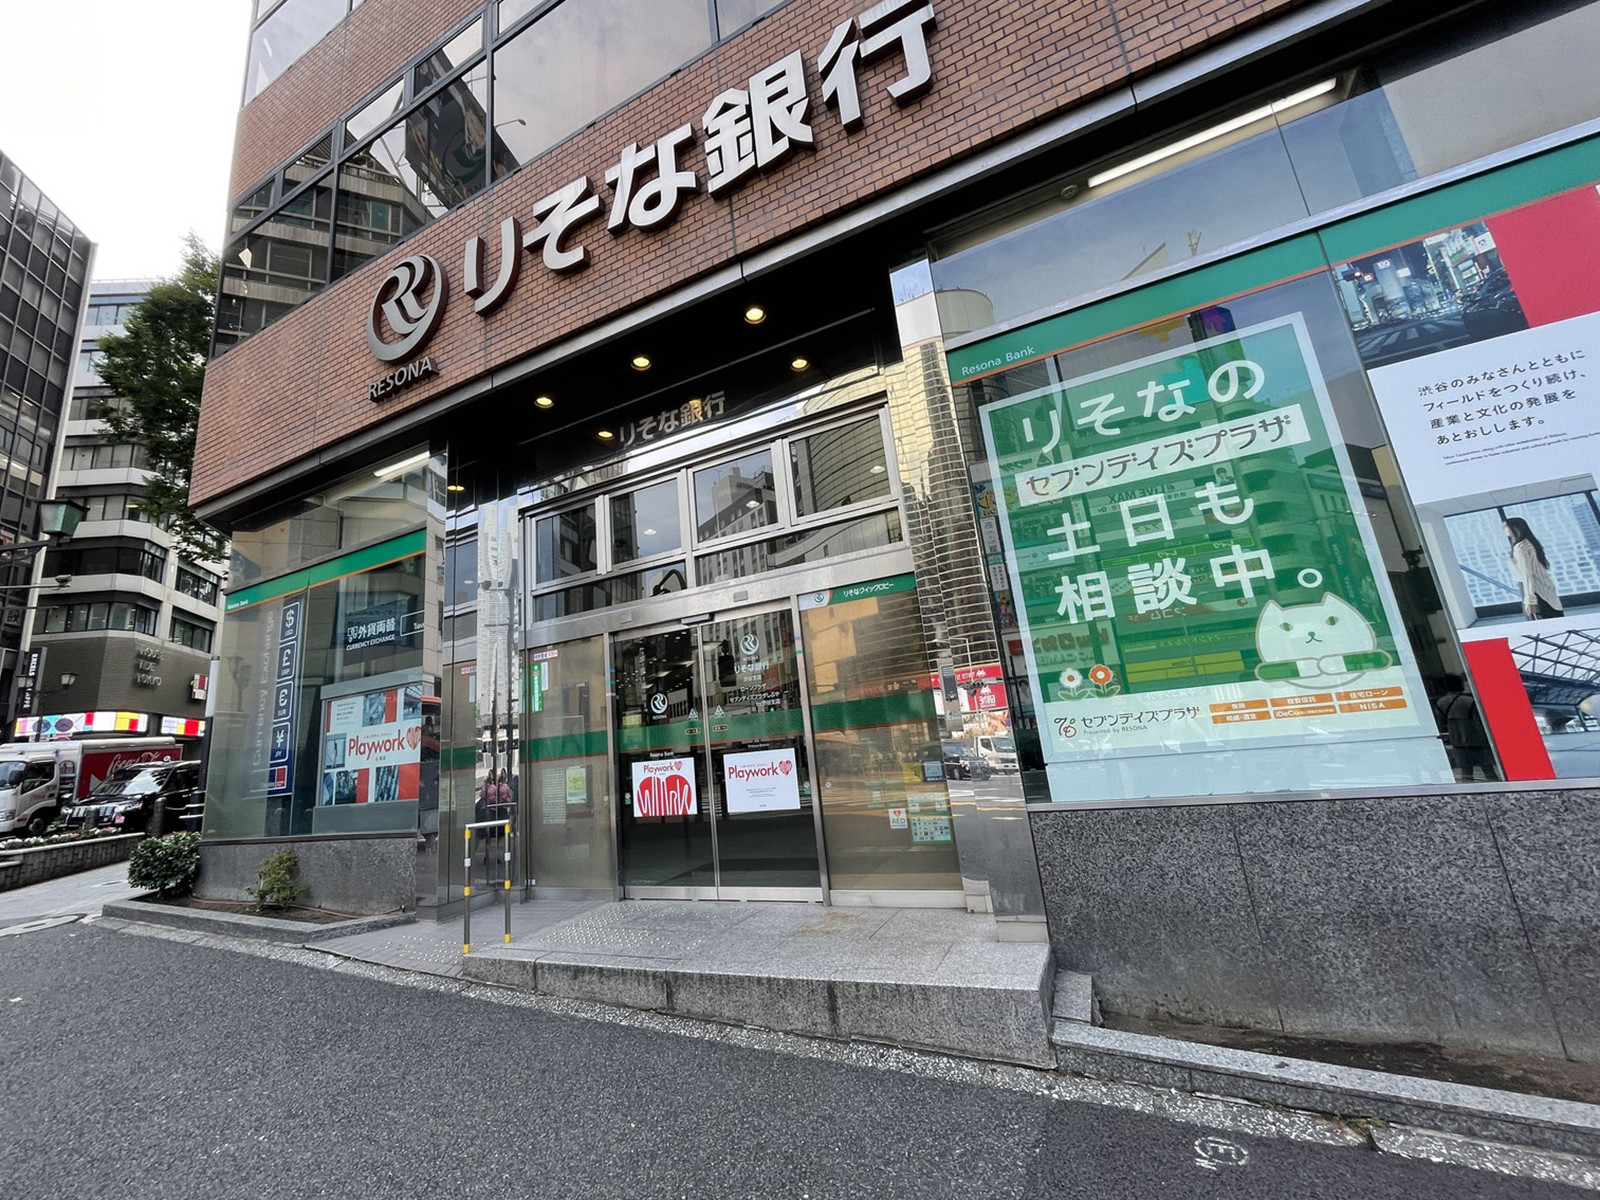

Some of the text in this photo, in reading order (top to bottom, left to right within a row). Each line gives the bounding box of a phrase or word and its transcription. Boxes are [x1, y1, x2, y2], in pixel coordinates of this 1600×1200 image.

[463, 0, 936, 317] りそな銀行
[961, 345, 1036, 377] Resona Bank
[1417, 349, 1587, 397] 渋谷のみなさんとともに
[367, 356, 439, 403] RESONA
[1423, 369, 1587, 413] フィールドをつくり続け、
[620, 391, 725, 447] りそな銀行
[1022, 359, 1266, 455] りそなの
[1429, 388, 1577, 430] 産業と文化の発展を
[1436, 417, 1545, 446] あとおしします。
[1026, 414, 1292, 499] セブンデイズプラザ
[1046, 480, 1254, 561] 土日も
[843, 582, 894, 598] りそなクイックロビー
[1056, 545, 1322, 625] 相談中。
[357, 617, 396, 639] 外貨両替
[734, 660, 770, 674] りそな銀行
[1080, 706, 1200, 728] セブンデイズプラザ
[1359, 702, 1386, 711] NISA
[348, 728, 405, 761] Playwork
[1083, 726, 1111, 735] Presented
[643, 763, 675, 775] Playwork
[728, 761, 779, 782] Playwork
[892, 817, 906, 825] AED
